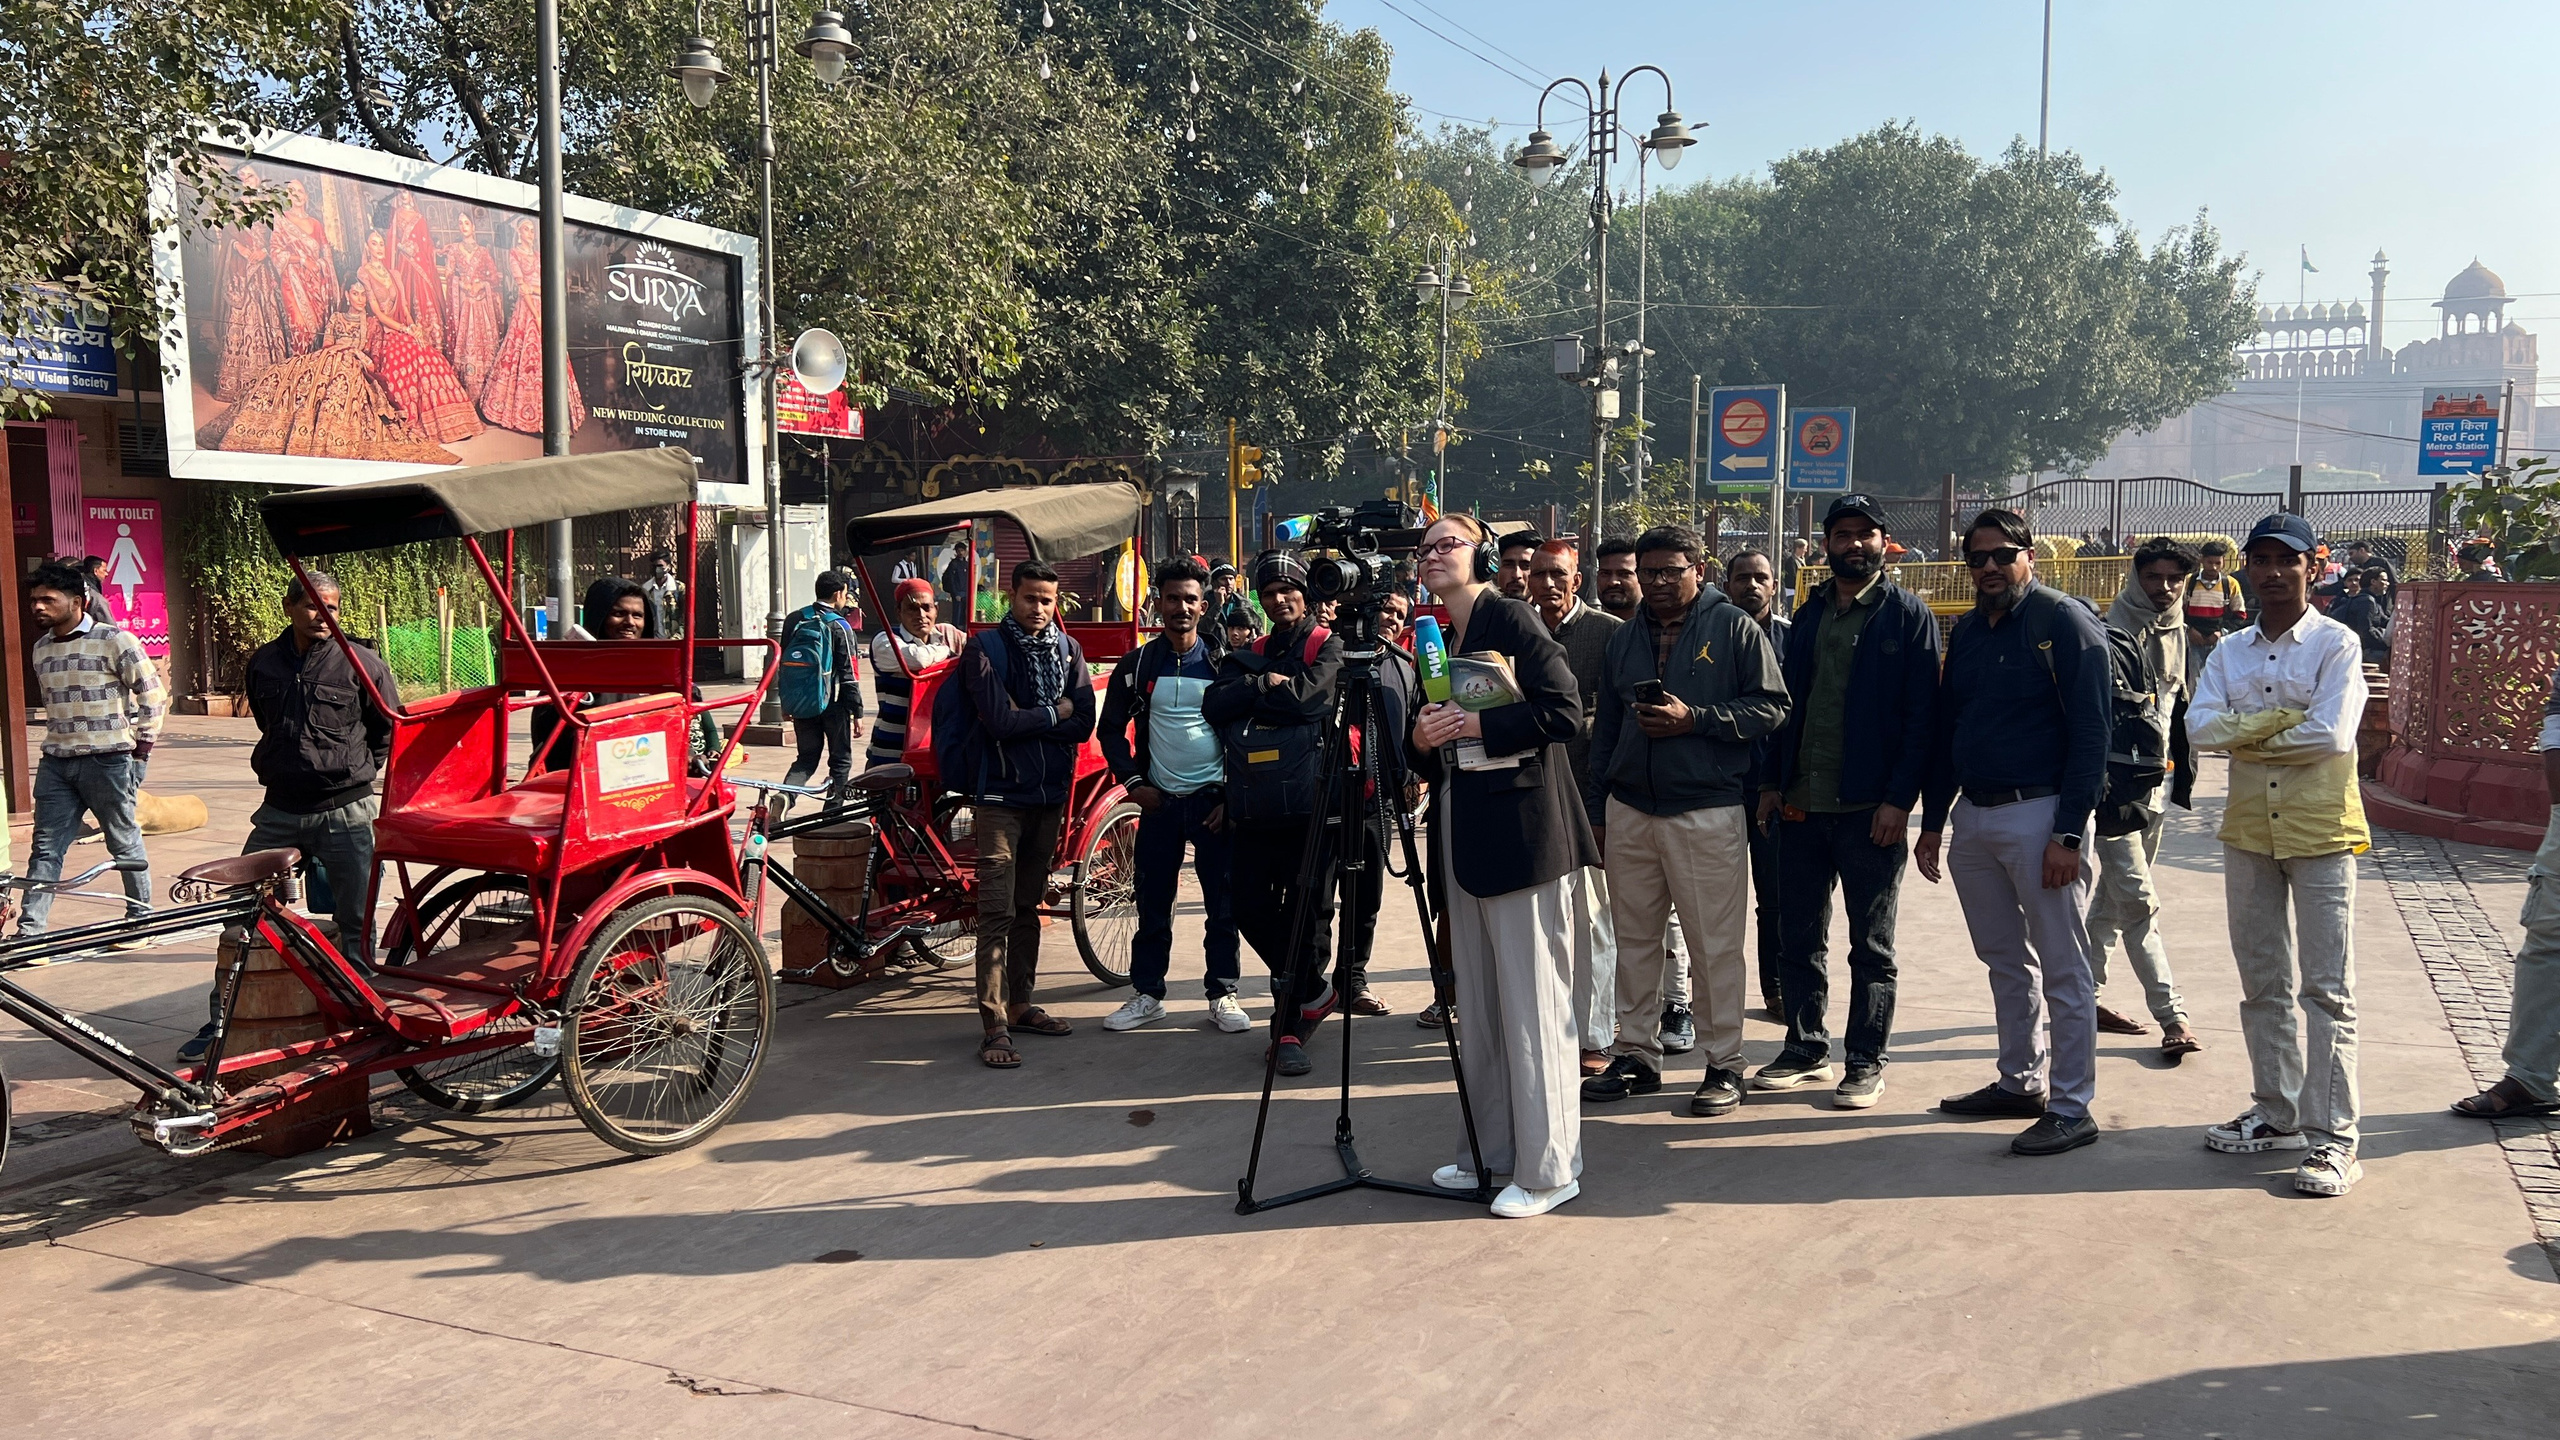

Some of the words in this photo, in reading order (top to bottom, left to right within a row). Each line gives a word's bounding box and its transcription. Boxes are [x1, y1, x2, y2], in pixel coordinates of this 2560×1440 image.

[607, 270, 707, 322] SURYA
[65, 352, 80, 364] No.
[82, 353, 88, 364] 1
[37, 371, 70, 385] Vision
[72, 374, 110, 391] Society
[592, 406, 617, 419] NEW
[618, 409, 666, 424] WEDDING
[667, 414, 725, 431] COLLECTION
[2431, 422, 2455, 431] लाल
[2460, 419, 2489, 431] किला
[635, 426, 644, 435] IN
[644, 427, 669, 438] STORE
[669, 430, 688, 439] NOW
[2433, 432, 2457, 442] Red
[2460, 432, 2485, 442] Fort
[2425, 442, 2453, 451] Metro
[2455, 442, 2490, 450] Station
[1815, 460, 1845, 468] Vehicles
[1800, 468, 1837, 476] Prohibited
[89, 507, 117, 520] PINK
[118, 507, 155, 520] TOILET
[61, 1013, 117, 1047] NEELAM
